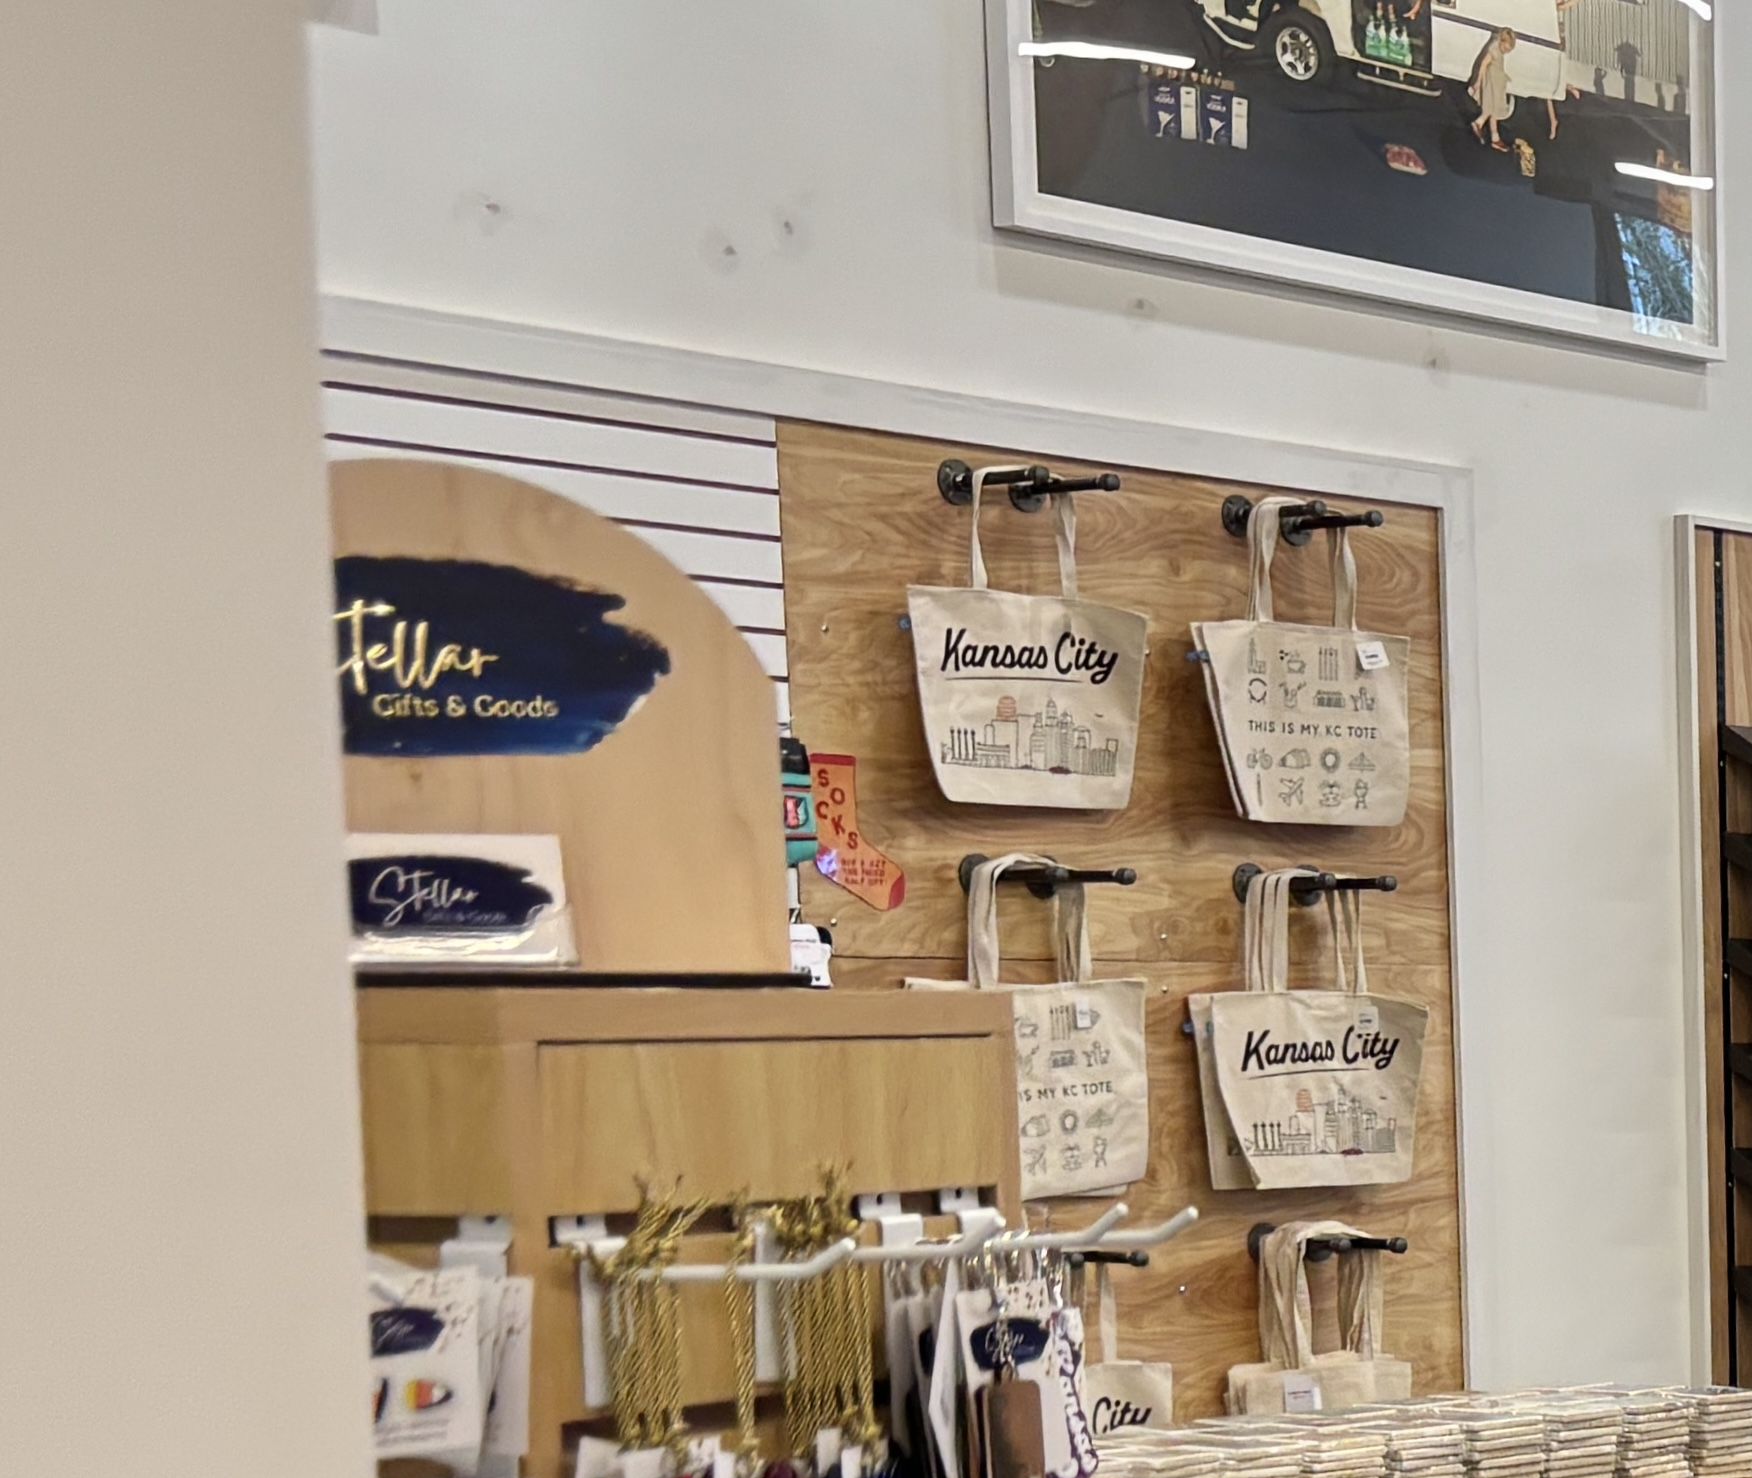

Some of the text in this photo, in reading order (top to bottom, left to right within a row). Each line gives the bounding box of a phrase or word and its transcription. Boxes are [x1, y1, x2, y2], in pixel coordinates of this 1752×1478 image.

[333, 599, 500, 695] tellar
[941, 627, 1119, 684] Kansas City
[372, 693, 560, 718] Gifts & Goods
[1248, 720, 1377, 740] THIS IS MY KC TOTE
[368, 866, 480, 928] Stellar
[1241, 1025, 1400, 1072] Kansas City
[1037, 1087, 1057, 1100] MY
[1062, 1084, 1079, 1097] KC
[1082, 1081, 1113, 1095] TOTE
